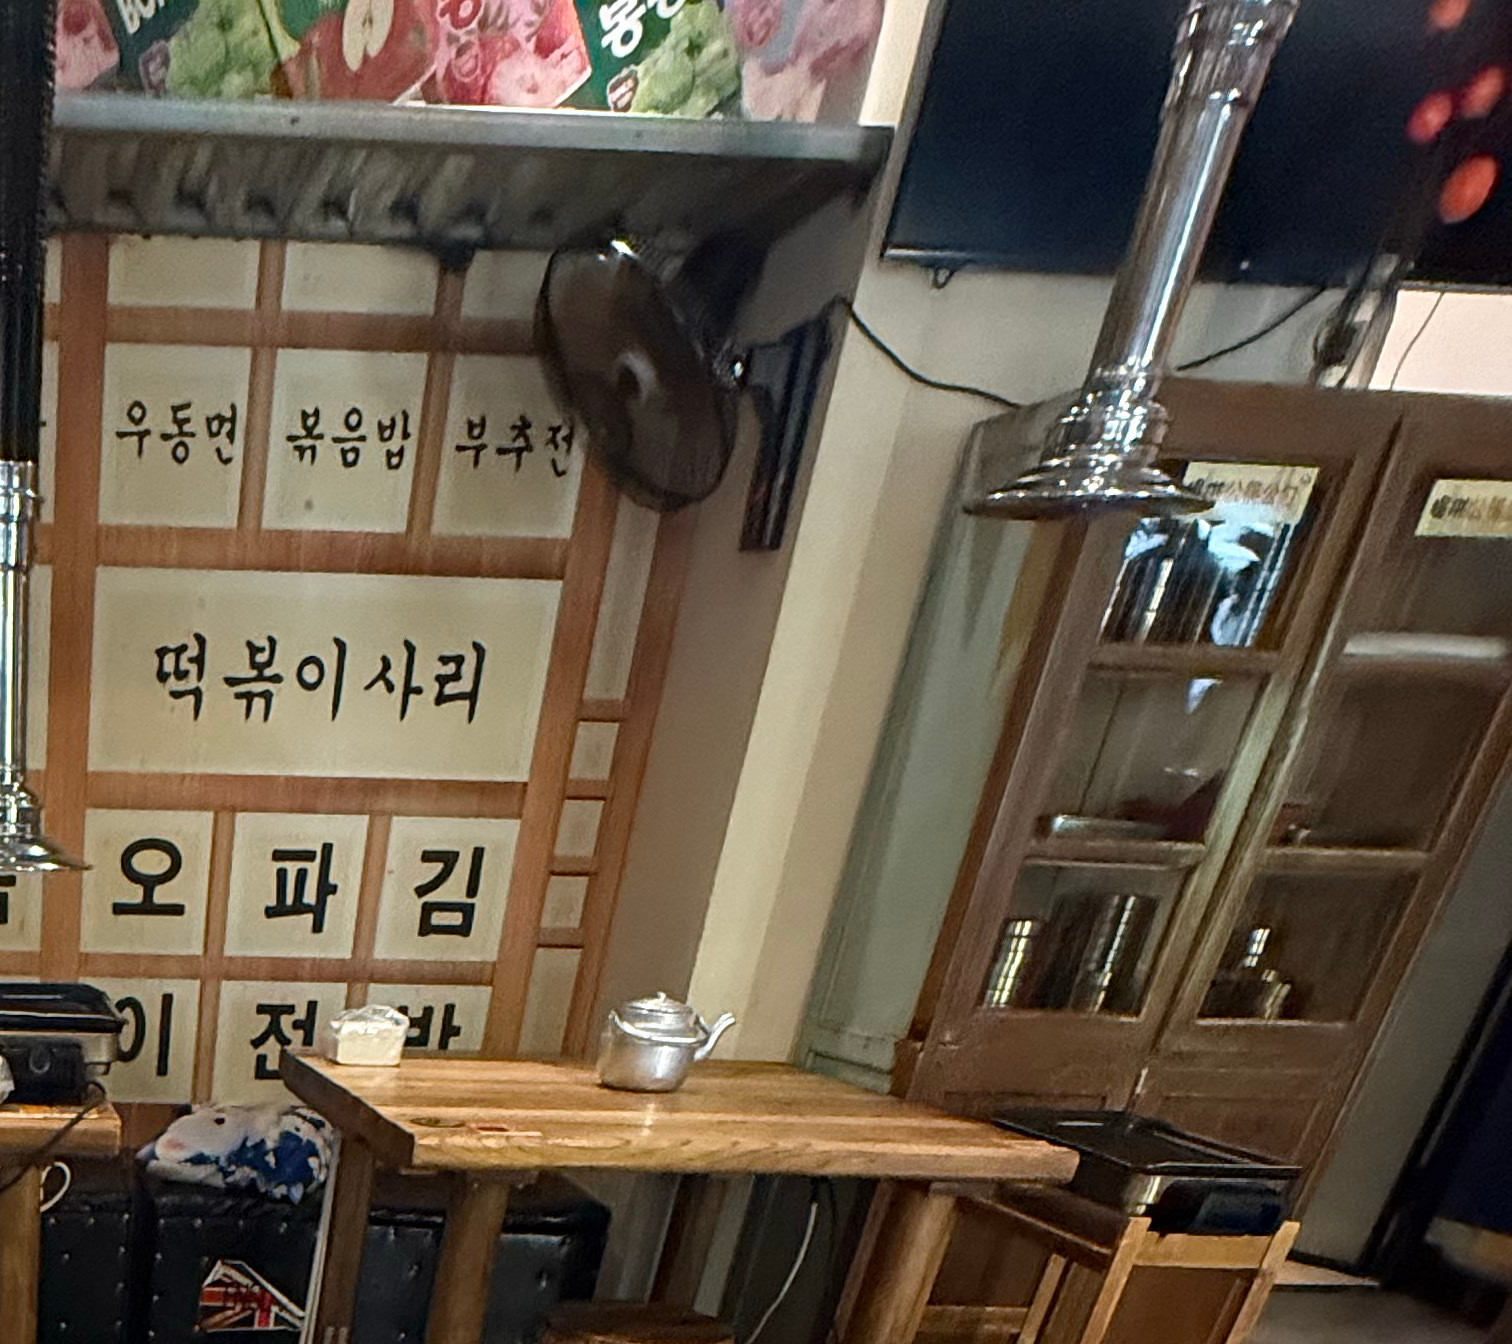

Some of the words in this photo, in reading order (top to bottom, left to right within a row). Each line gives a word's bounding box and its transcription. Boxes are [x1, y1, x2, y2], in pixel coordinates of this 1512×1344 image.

[115, 400, 238, 466] 우동면
[285, 406, 413, 471] 볶음밥
[454, 413, 575, 478] 부추전
[154, 632, 486, 723] 떡볶이사리
